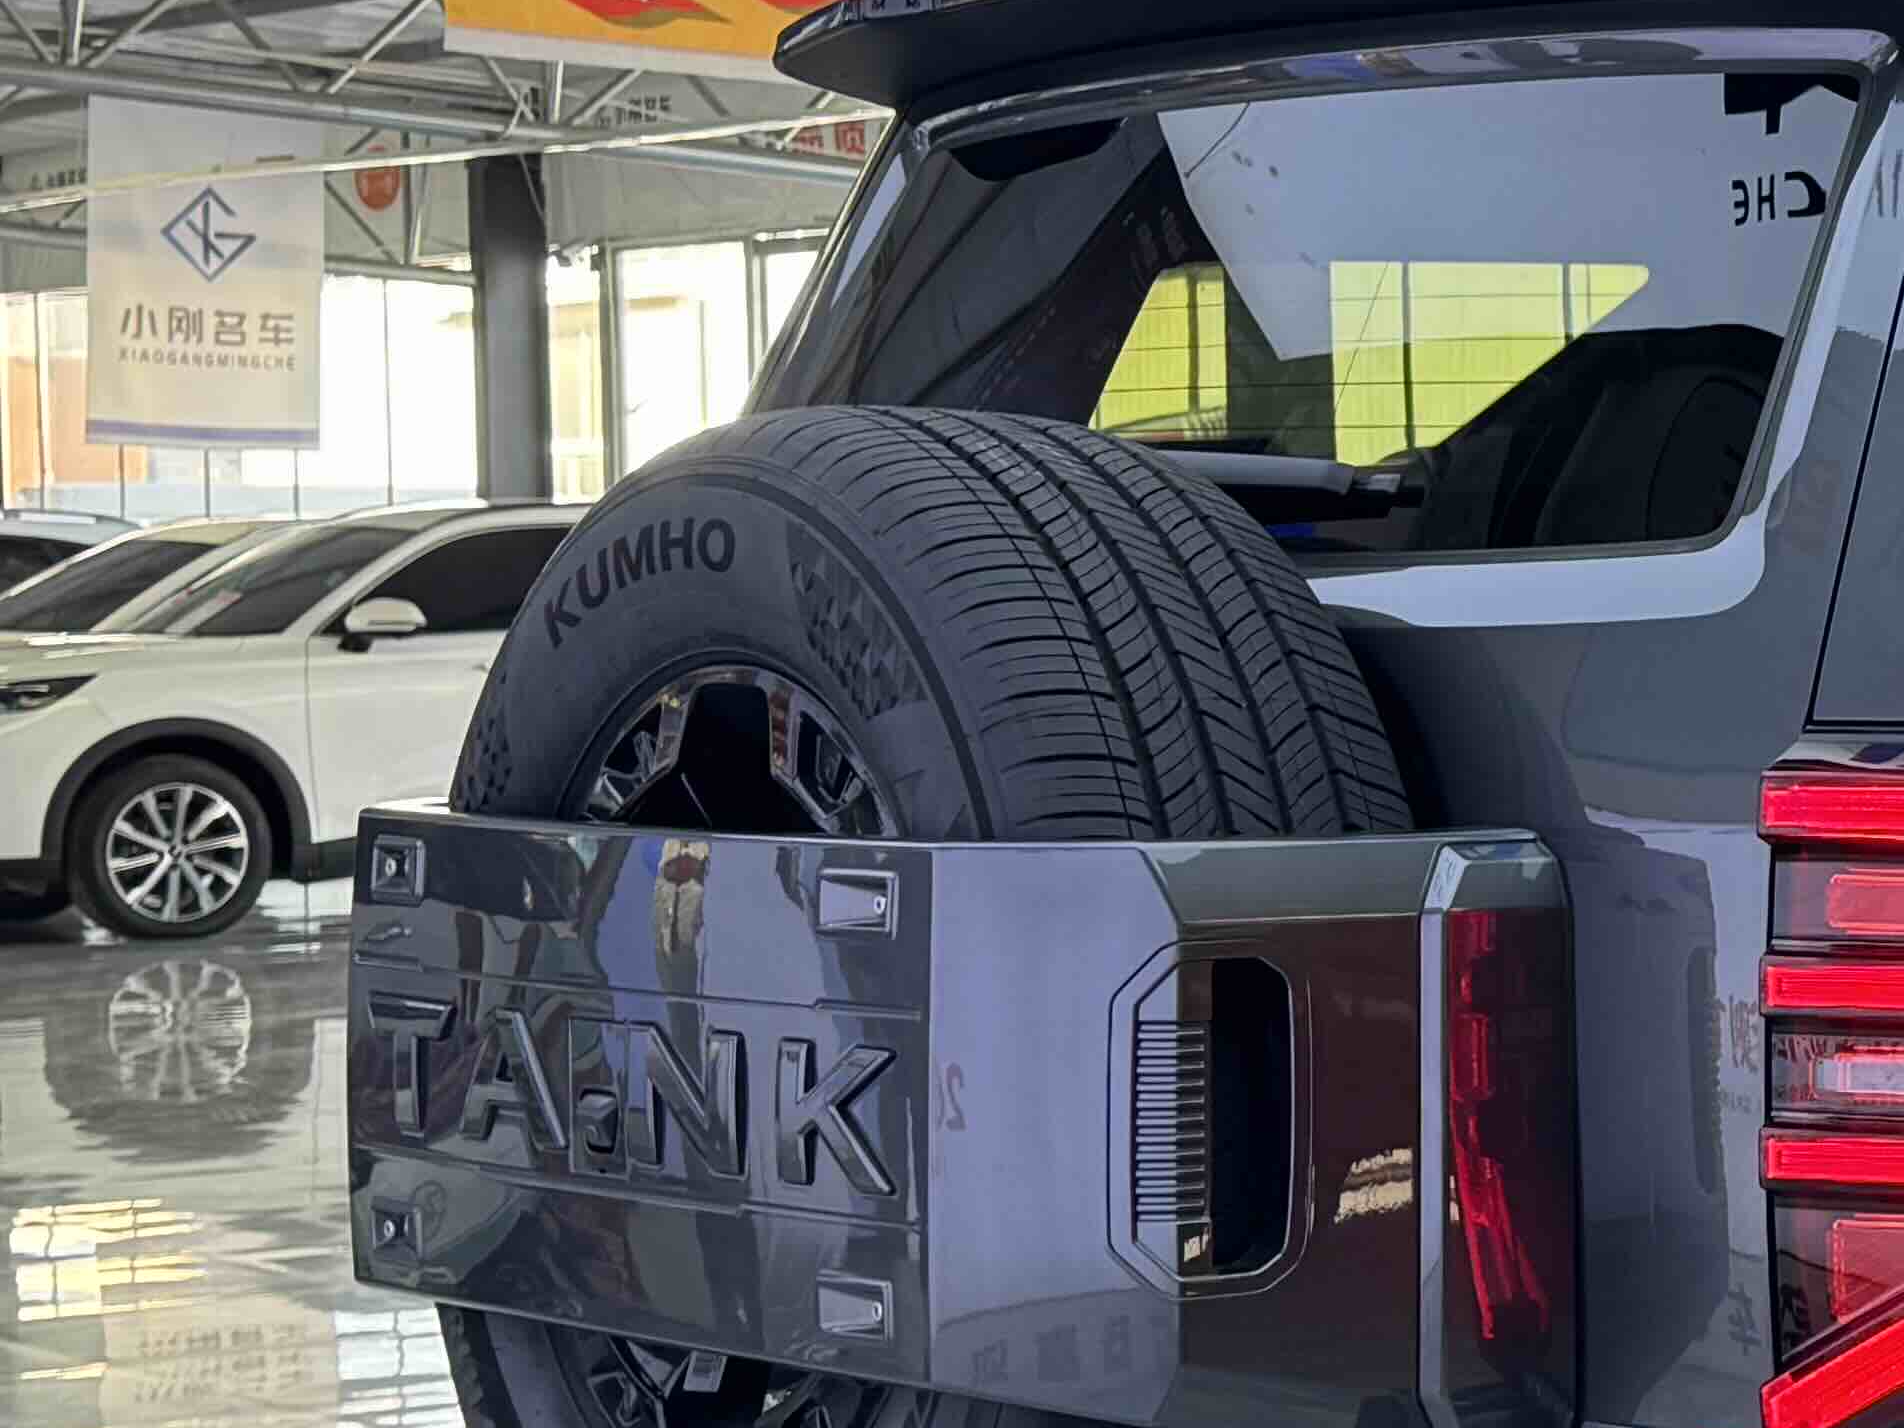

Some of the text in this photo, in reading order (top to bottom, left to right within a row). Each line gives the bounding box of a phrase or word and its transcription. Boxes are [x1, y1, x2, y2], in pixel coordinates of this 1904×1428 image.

[118, 348, 297, 371] XIAOGANGMINGCHE
[119, 303, 296, 348] 小刚名车
[543, 516, 736, 650] KUMHO
[367, 989, 899, 1198] TANK
